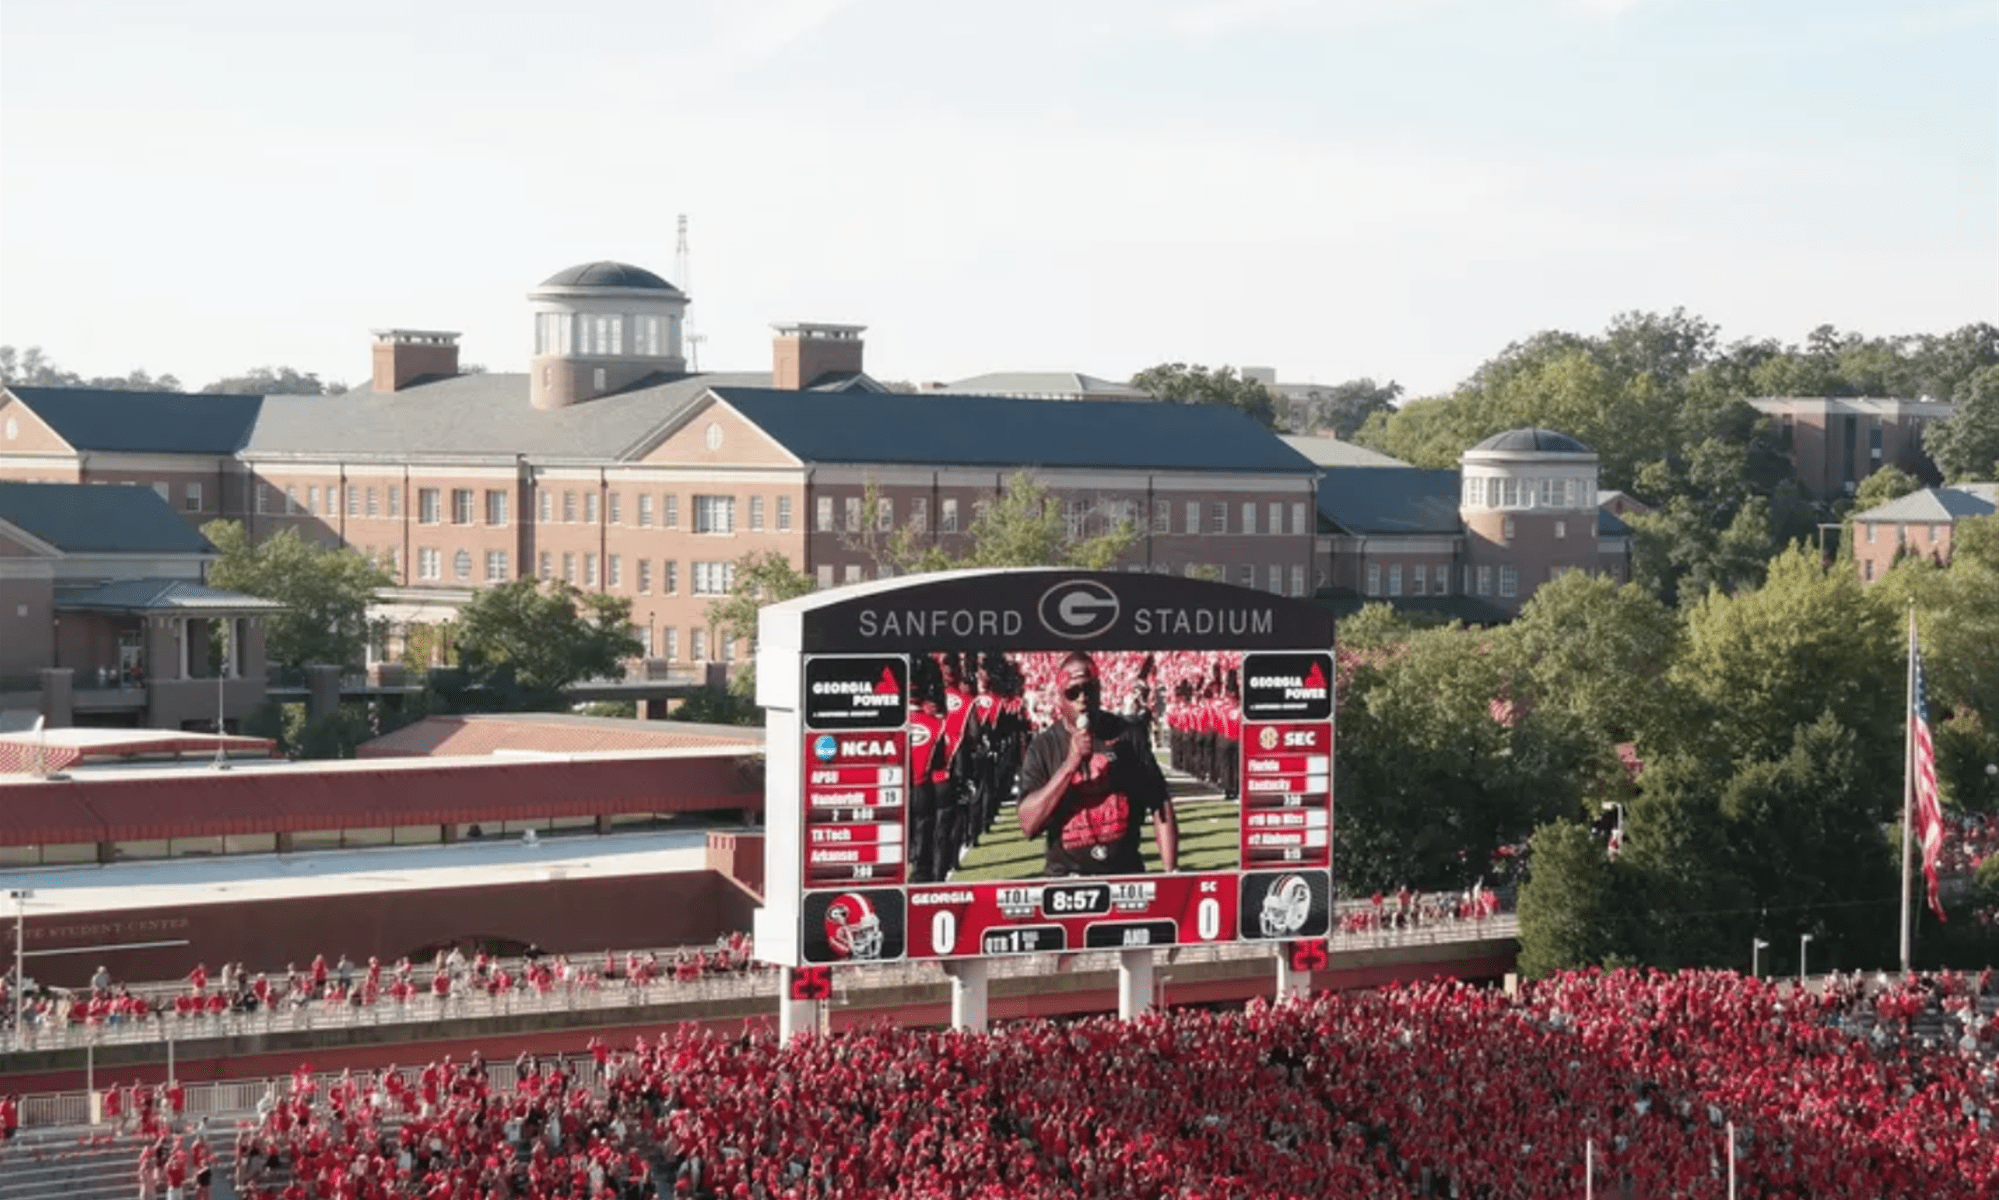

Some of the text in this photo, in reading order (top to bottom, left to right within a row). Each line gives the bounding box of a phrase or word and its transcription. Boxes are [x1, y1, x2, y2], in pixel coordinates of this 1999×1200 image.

[859, 609, 1022, 637] SANFORD
[1134, 608, 1274, 635] STADIUM
[812, 681, 873, 694] GEORGIA
[1249, 676, 1304, 690] GEORGIA
[853, 694, 900, 707] POWER
[1285, 688, 1327, 701] POWER
[841, 741, 897, 757] NCAA
[1283, 731, 1317, 747] SEC
[911, 890, 975, 905] GEORGIA
[1052, 889, 1100, 911] 8:57
[1200, 880, 1218, 893] SC
[49, 923, 123, 938] STUDENT
[127, 917, 190, 932] CENTER
[1198, 897, 1220, 940] 0
[932, 909, 956, 955] 0
[1009, 930, 1020, 952] 1
[1290, 939, 1328, 972] 25
[791, 965, 831, 1000] 25
